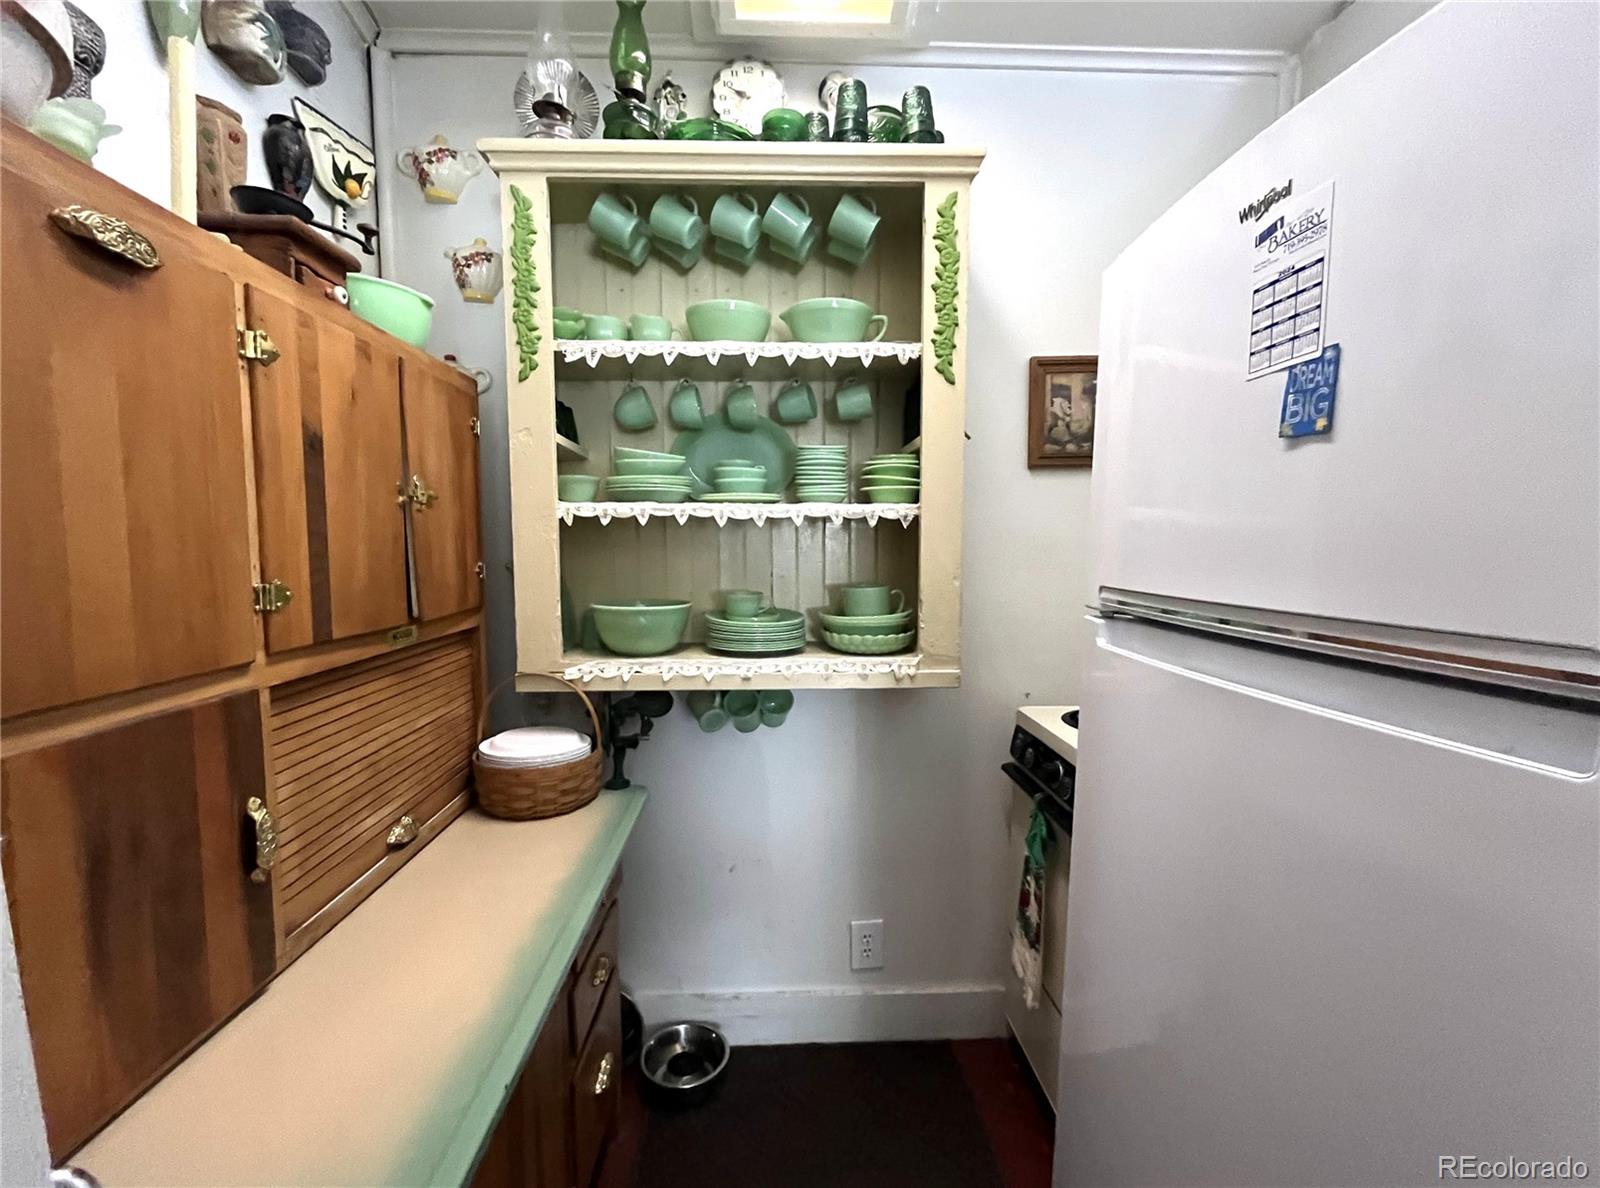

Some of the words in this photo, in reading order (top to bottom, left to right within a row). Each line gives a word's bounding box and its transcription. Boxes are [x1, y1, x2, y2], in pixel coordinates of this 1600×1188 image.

[723, 80, 733, 88] 10
[743, 66, 754, 74] 12
[1239, 179, 1293, 224] Whirlpool
[1268, 208, 1325, 254] BAKERY
[1285, 387, 1330, 424] BIG
